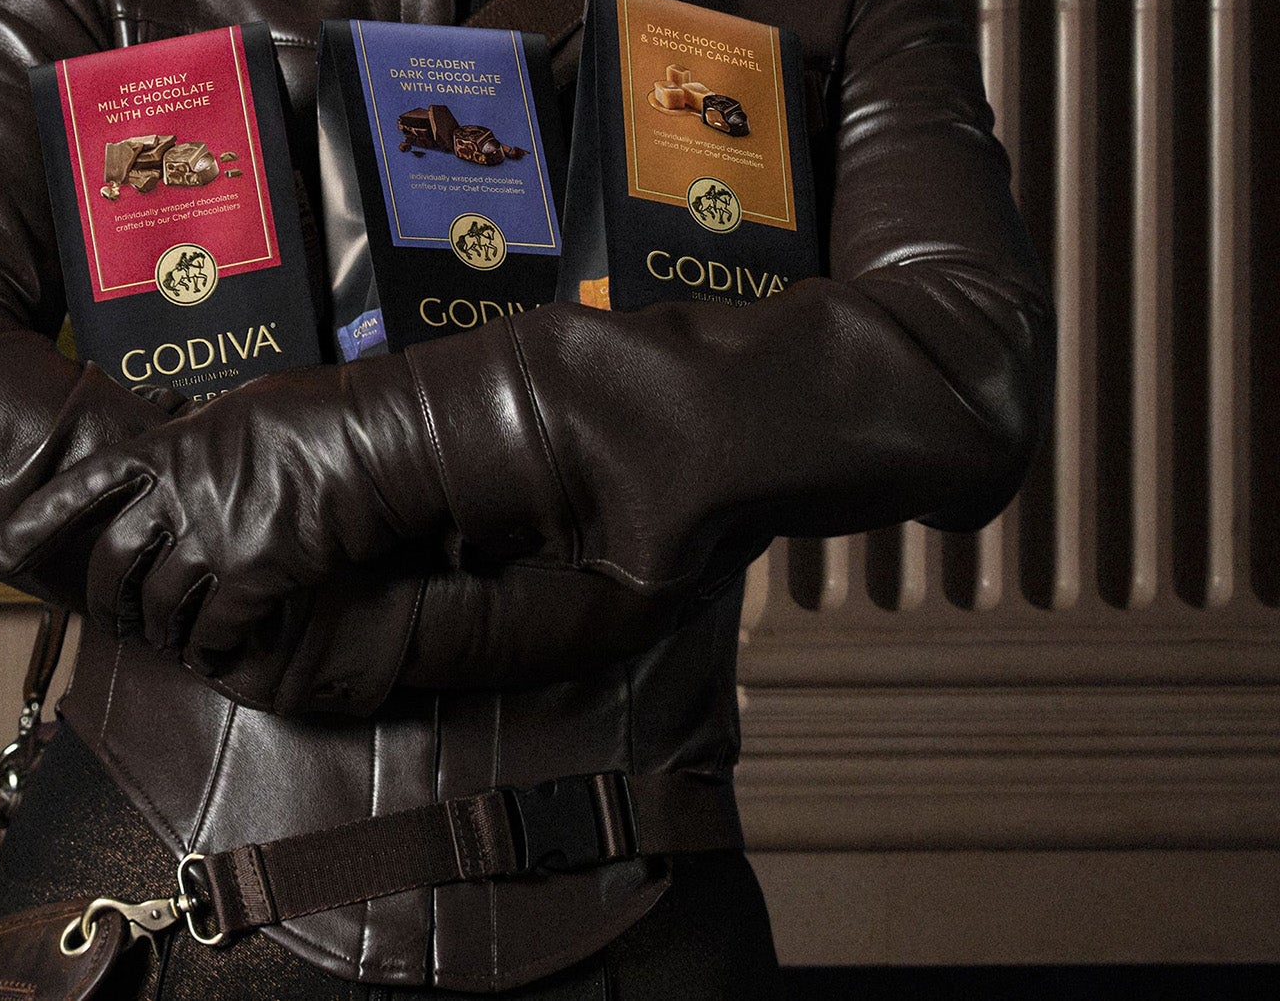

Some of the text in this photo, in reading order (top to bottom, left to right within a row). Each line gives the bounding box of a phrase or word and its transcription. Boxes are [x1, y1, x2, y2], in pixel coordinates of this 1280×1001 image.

[640, 34, 762, 72] & SMOOTH CARAMEL
[646, 24, 754, 59] DARK CHOCOLATE
[390, 68, 501, 84] DARK CHOCOLATE
[409, 57, 476, 70] DECADENT
[98, 81, 215, 112] MILK CHOCOLATE
[120, 72, 188, 95] HEAVENLY
[400, 82, 496, 96] WITH GANACHE
[106, 95, 211, 124] WITH GANACHE
[654, 139, 679, 150] crafted
[680, 144, 690, 153] by
[704, 149, 721, 159] Chef
[721, 153, 764, 169] Chocolatiers
[694, 140, 725, 152] wrapped
[726, 146, 763, 160] chocolates
[438, 183, 448, 191] by
[481, 185, 525, 195] Chocolatiers
[452, 176, 482, 184] wrapped
[484, 176, 523, 185] chocolates
[114, 192, 239, 222] Individually wrapped chocolates
[115, 202, 241, 233] crafted by our Chef Chocolatiers
[646, 250, 785, 298] GODIVA
[121, 325, 282, 382] GODIVA
[172, 368, 239, 387] BELGIUM 1926
